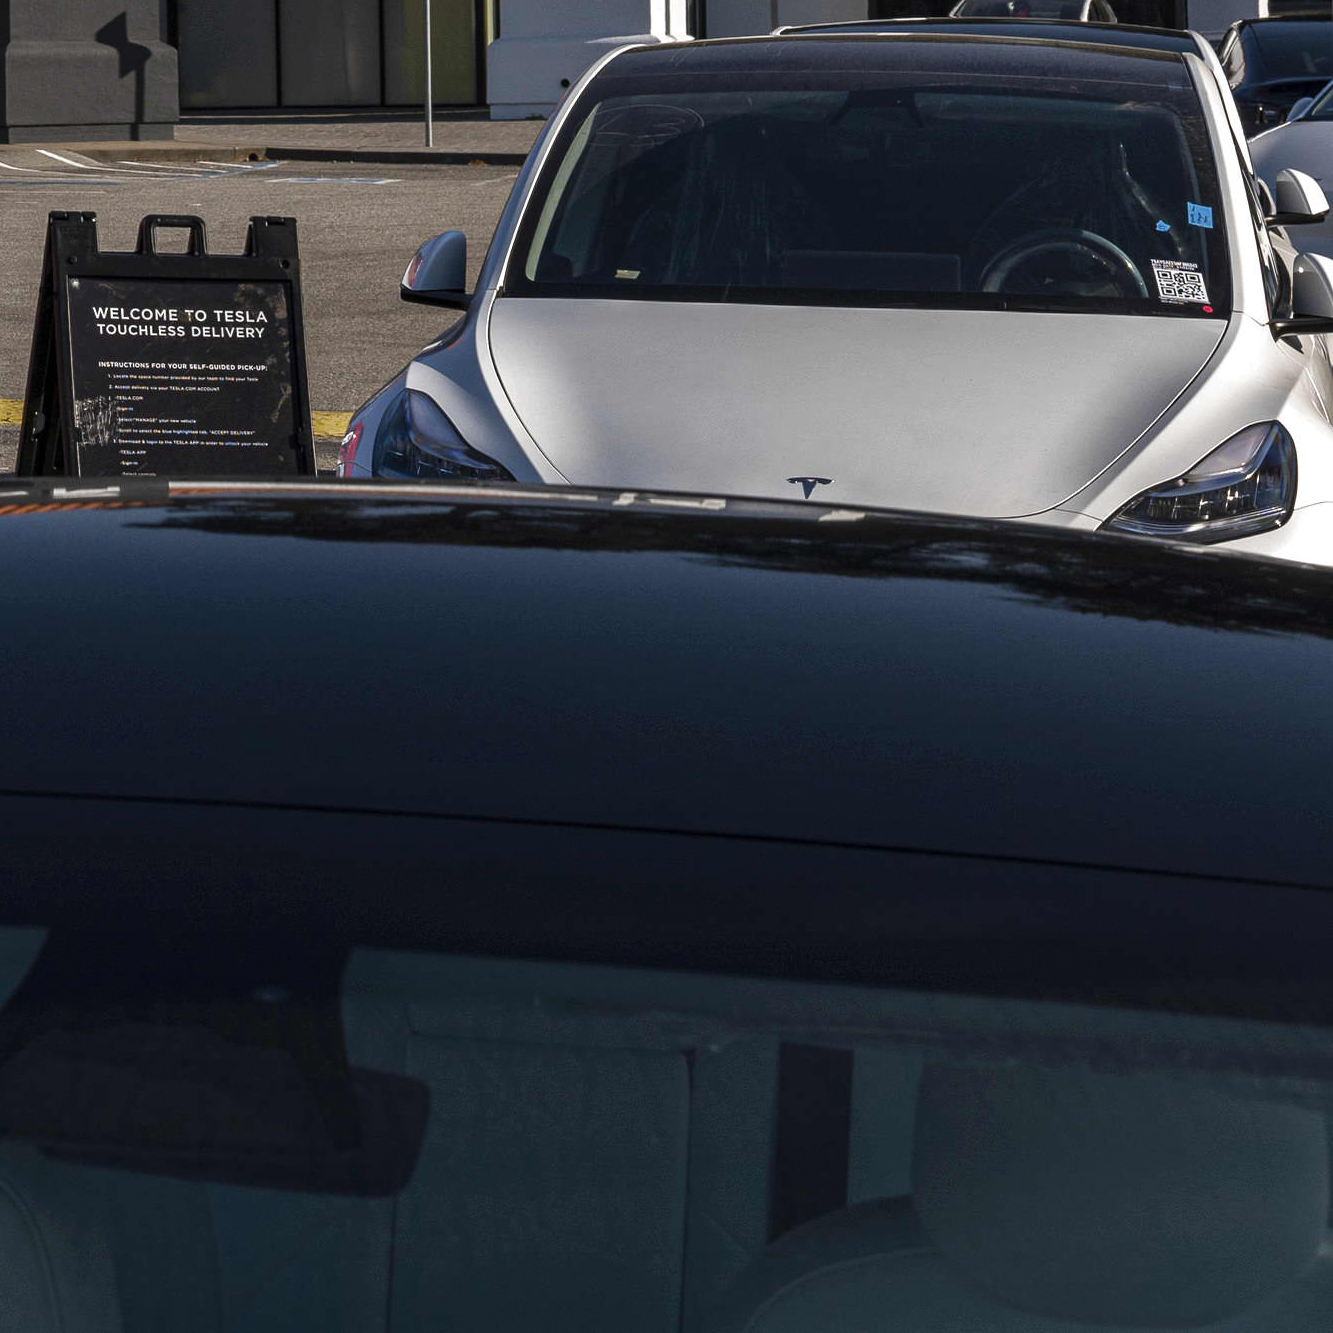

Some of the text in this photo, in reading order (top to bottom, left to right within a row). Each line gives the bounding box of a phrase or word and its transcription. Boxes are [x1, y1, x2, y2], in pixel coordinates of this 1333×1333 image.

[93, 306, 268, 323] WELCOME TO TESLA
[96, 323, 265, 338] TOUCHLESS DELIVERY
[98, 361, 150, 369] INSTRUCTIONS
[189, 363, 236, 371] SELF-GUIDED
[237, 364, 268, 372] PICK-UP:
